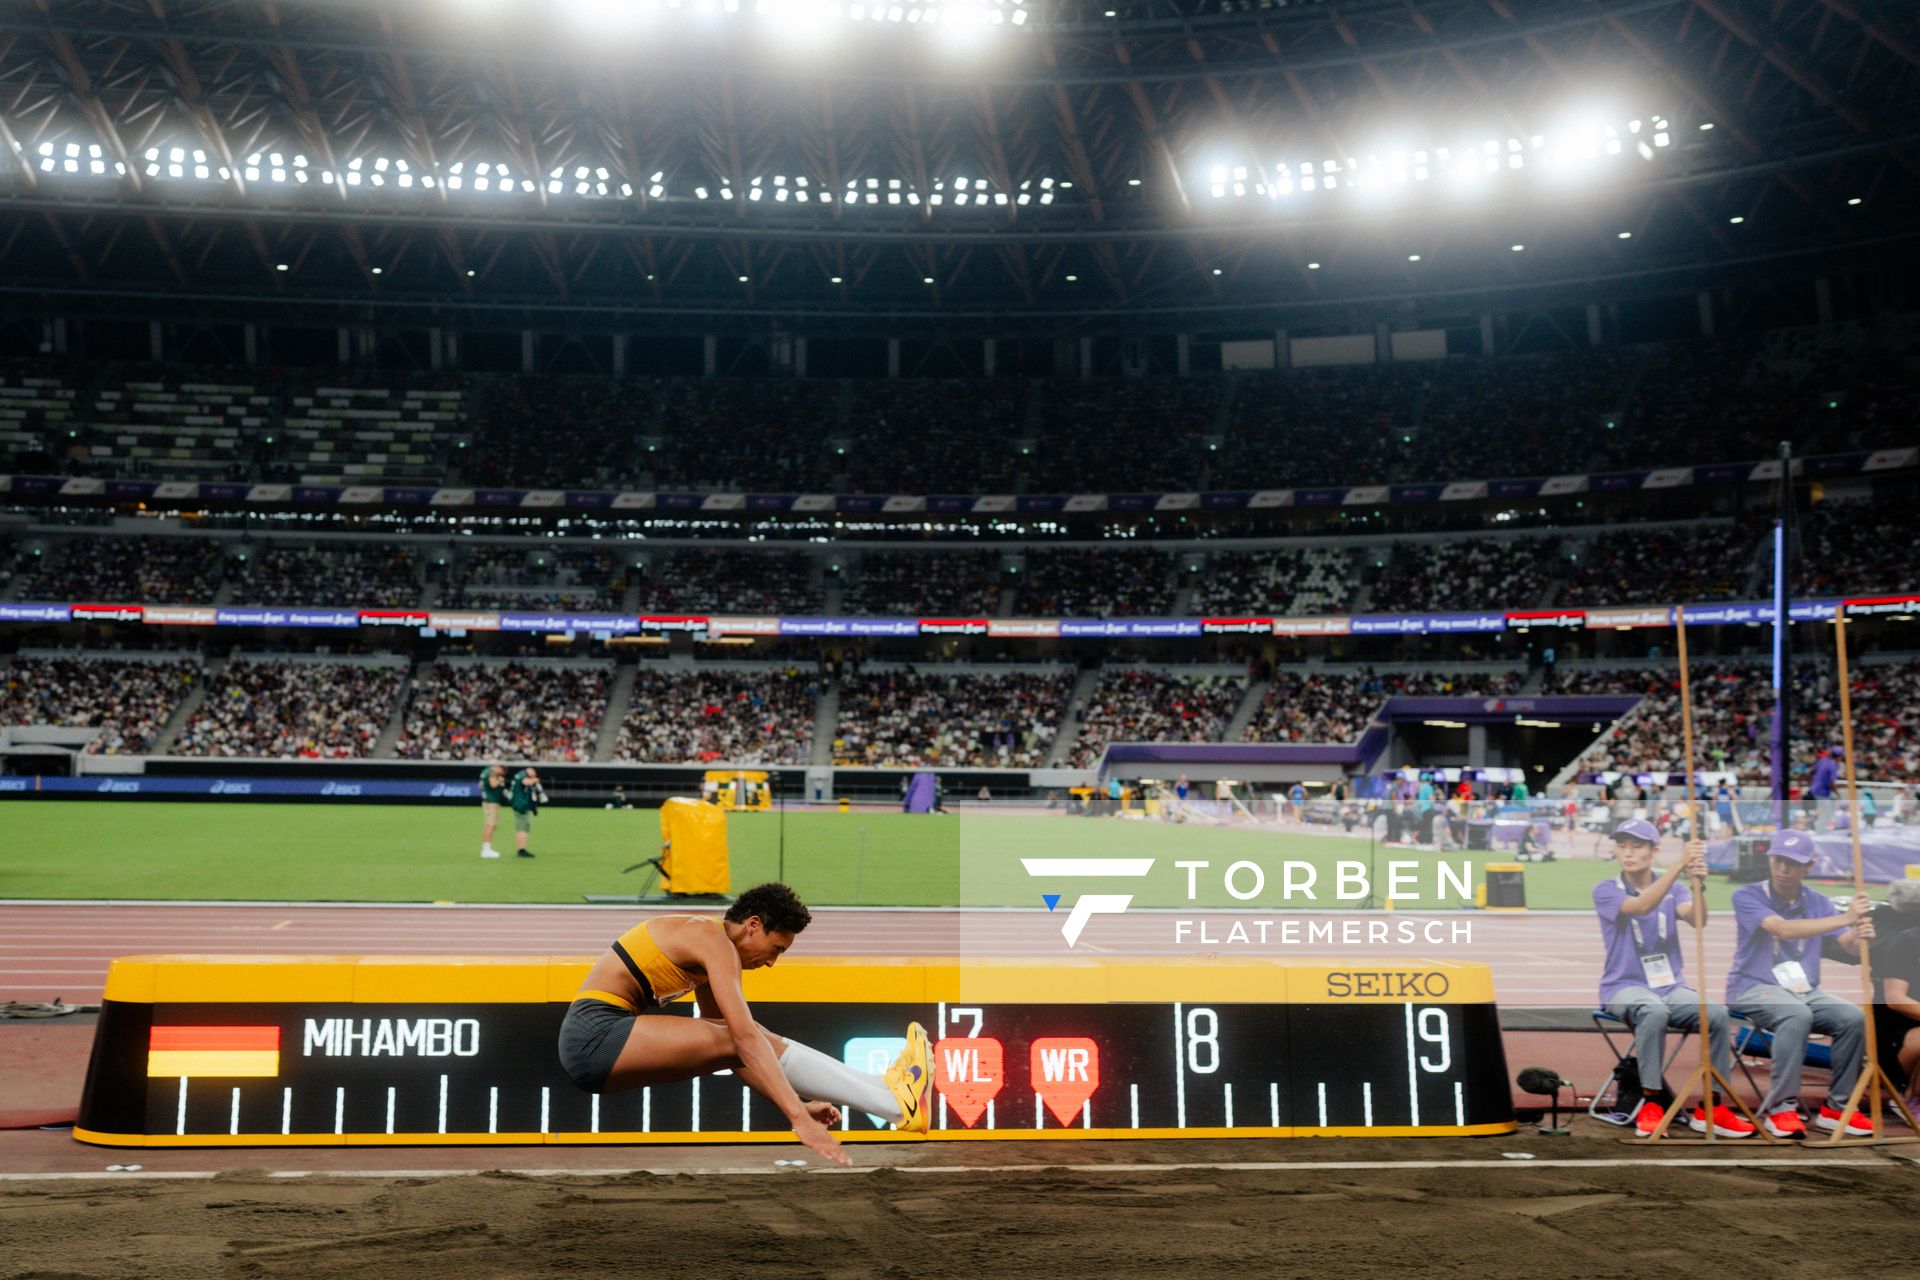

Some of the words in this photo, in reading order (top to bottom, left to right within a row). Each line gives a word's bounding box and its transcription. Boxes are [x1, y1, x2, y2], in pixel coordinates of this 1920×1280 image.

[1327, 972, 1449, 997] SEIKO
[303, 1018, 479, 1056] MIHAMBO
[951, 1008, 983, 1038] 7
[1187, 1008, 1219, 1073] 8
[1417, 1008, 1450, 1073] 9
[944, 1048, 993, 1083] WL
[1040, 1048, 1089, 1083] WR
